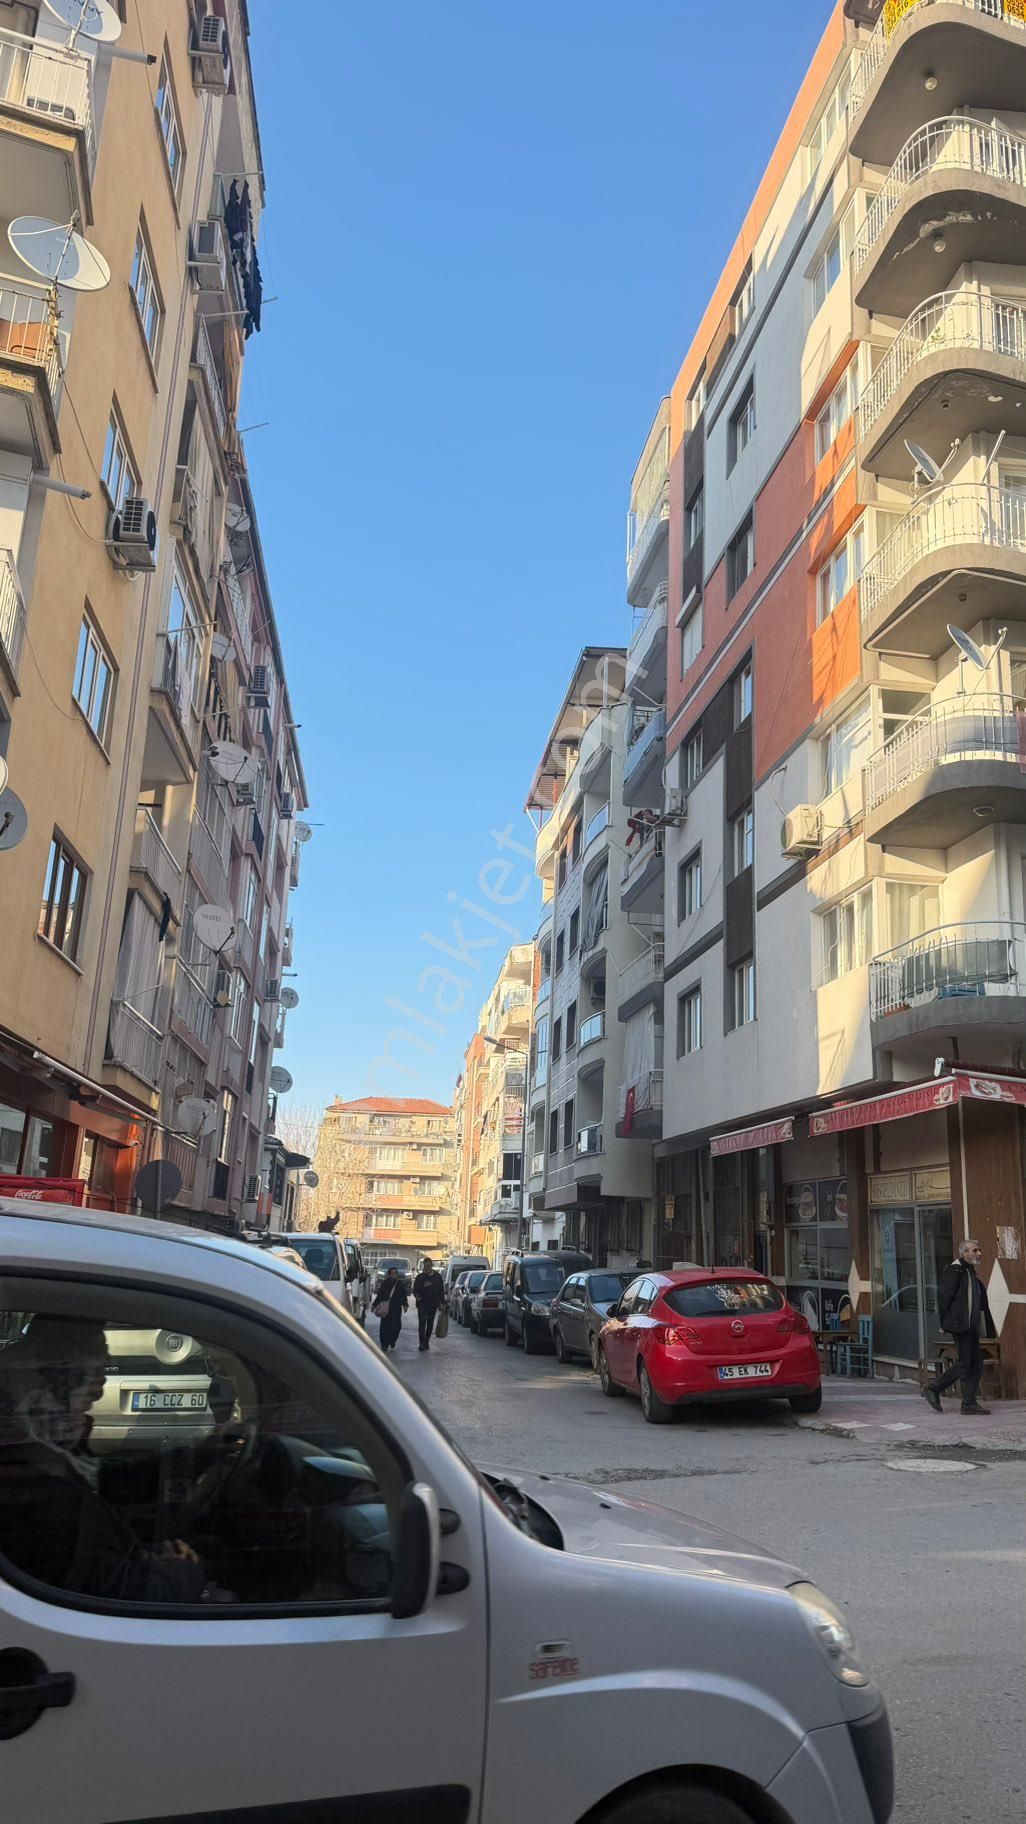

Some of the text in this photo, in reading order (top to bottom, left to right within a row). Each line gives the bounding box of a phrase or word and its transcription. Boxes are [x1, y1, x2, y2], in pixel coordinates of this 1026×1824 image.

[722, 1364, 770, 1377] 45 EK 744
[144, 1394, 156, 1407] 16
[163, 1394, 184, 1406] CCZ
[190, 1394, 204, 1406] 60
